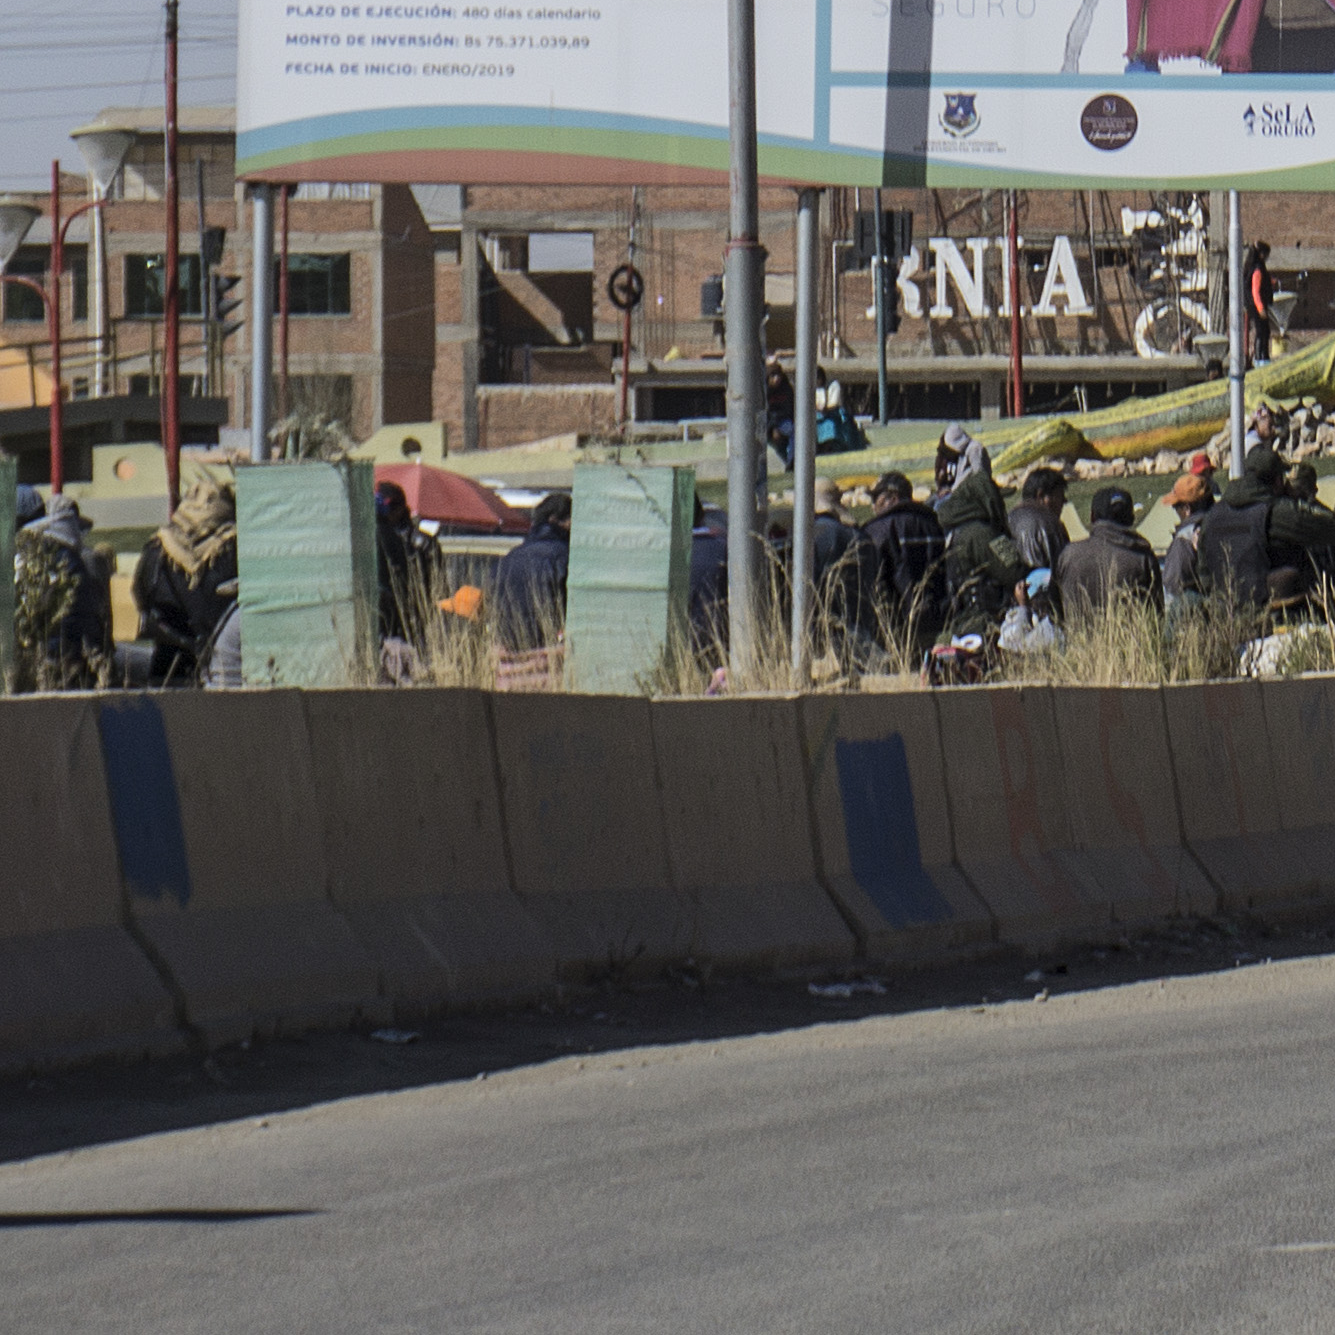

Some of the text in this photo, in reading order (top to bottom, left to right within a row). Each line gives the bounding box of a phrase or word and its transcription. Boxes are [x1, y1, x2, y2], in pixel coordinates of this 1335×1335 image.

[286, 5, 336, 18] PLAZO
[341, 6, 360, 18] DE
[527, 6, 602, 20] calendario
[285, 34, 340, 47] MONTO
[346, 34, 366, 47] DE
[285, 62, 334, 75] FECHA
[340, 62, 359, 75] DE
